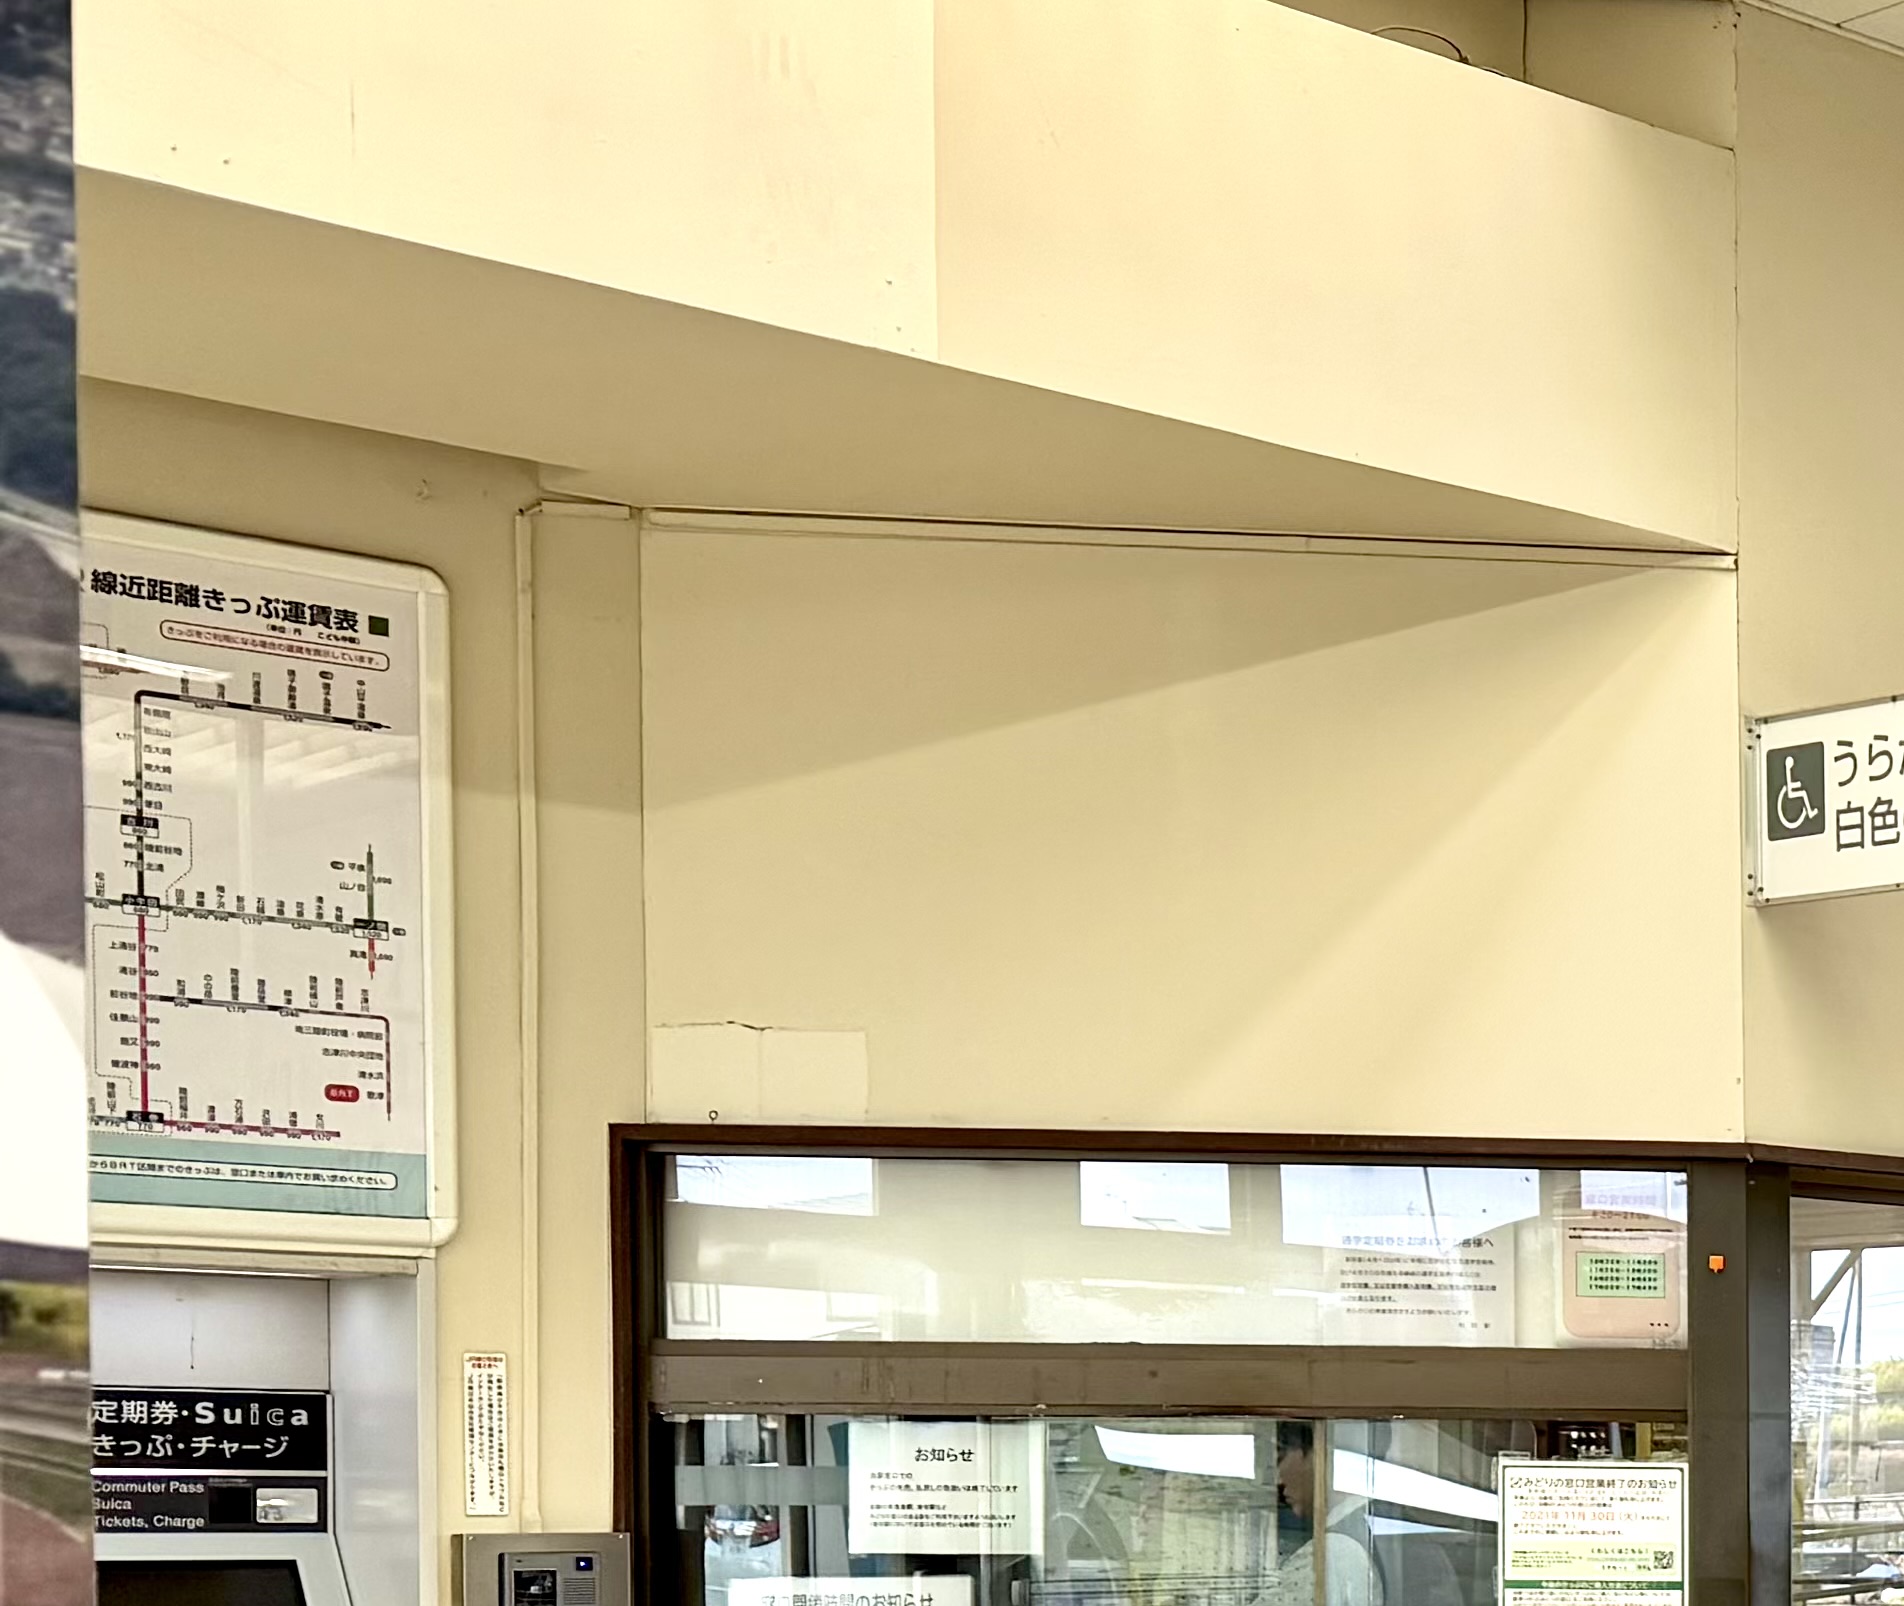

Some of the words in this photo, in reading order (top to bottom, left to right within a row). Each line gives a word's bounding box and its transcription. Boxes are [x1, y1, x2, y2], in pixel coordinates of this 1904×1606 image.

[80, 567, 359, 634] 線近距離きっぷ運賃表
[92, 1433, 290, 1459] きっぷ・チャージ
[914, 1447, 975, 1462] お知らせ
[92, 1480, 166, 1493] Commuter
[169, 1481, 205, 1493] Pass
[152, 1515, 205, 1530] Charge
